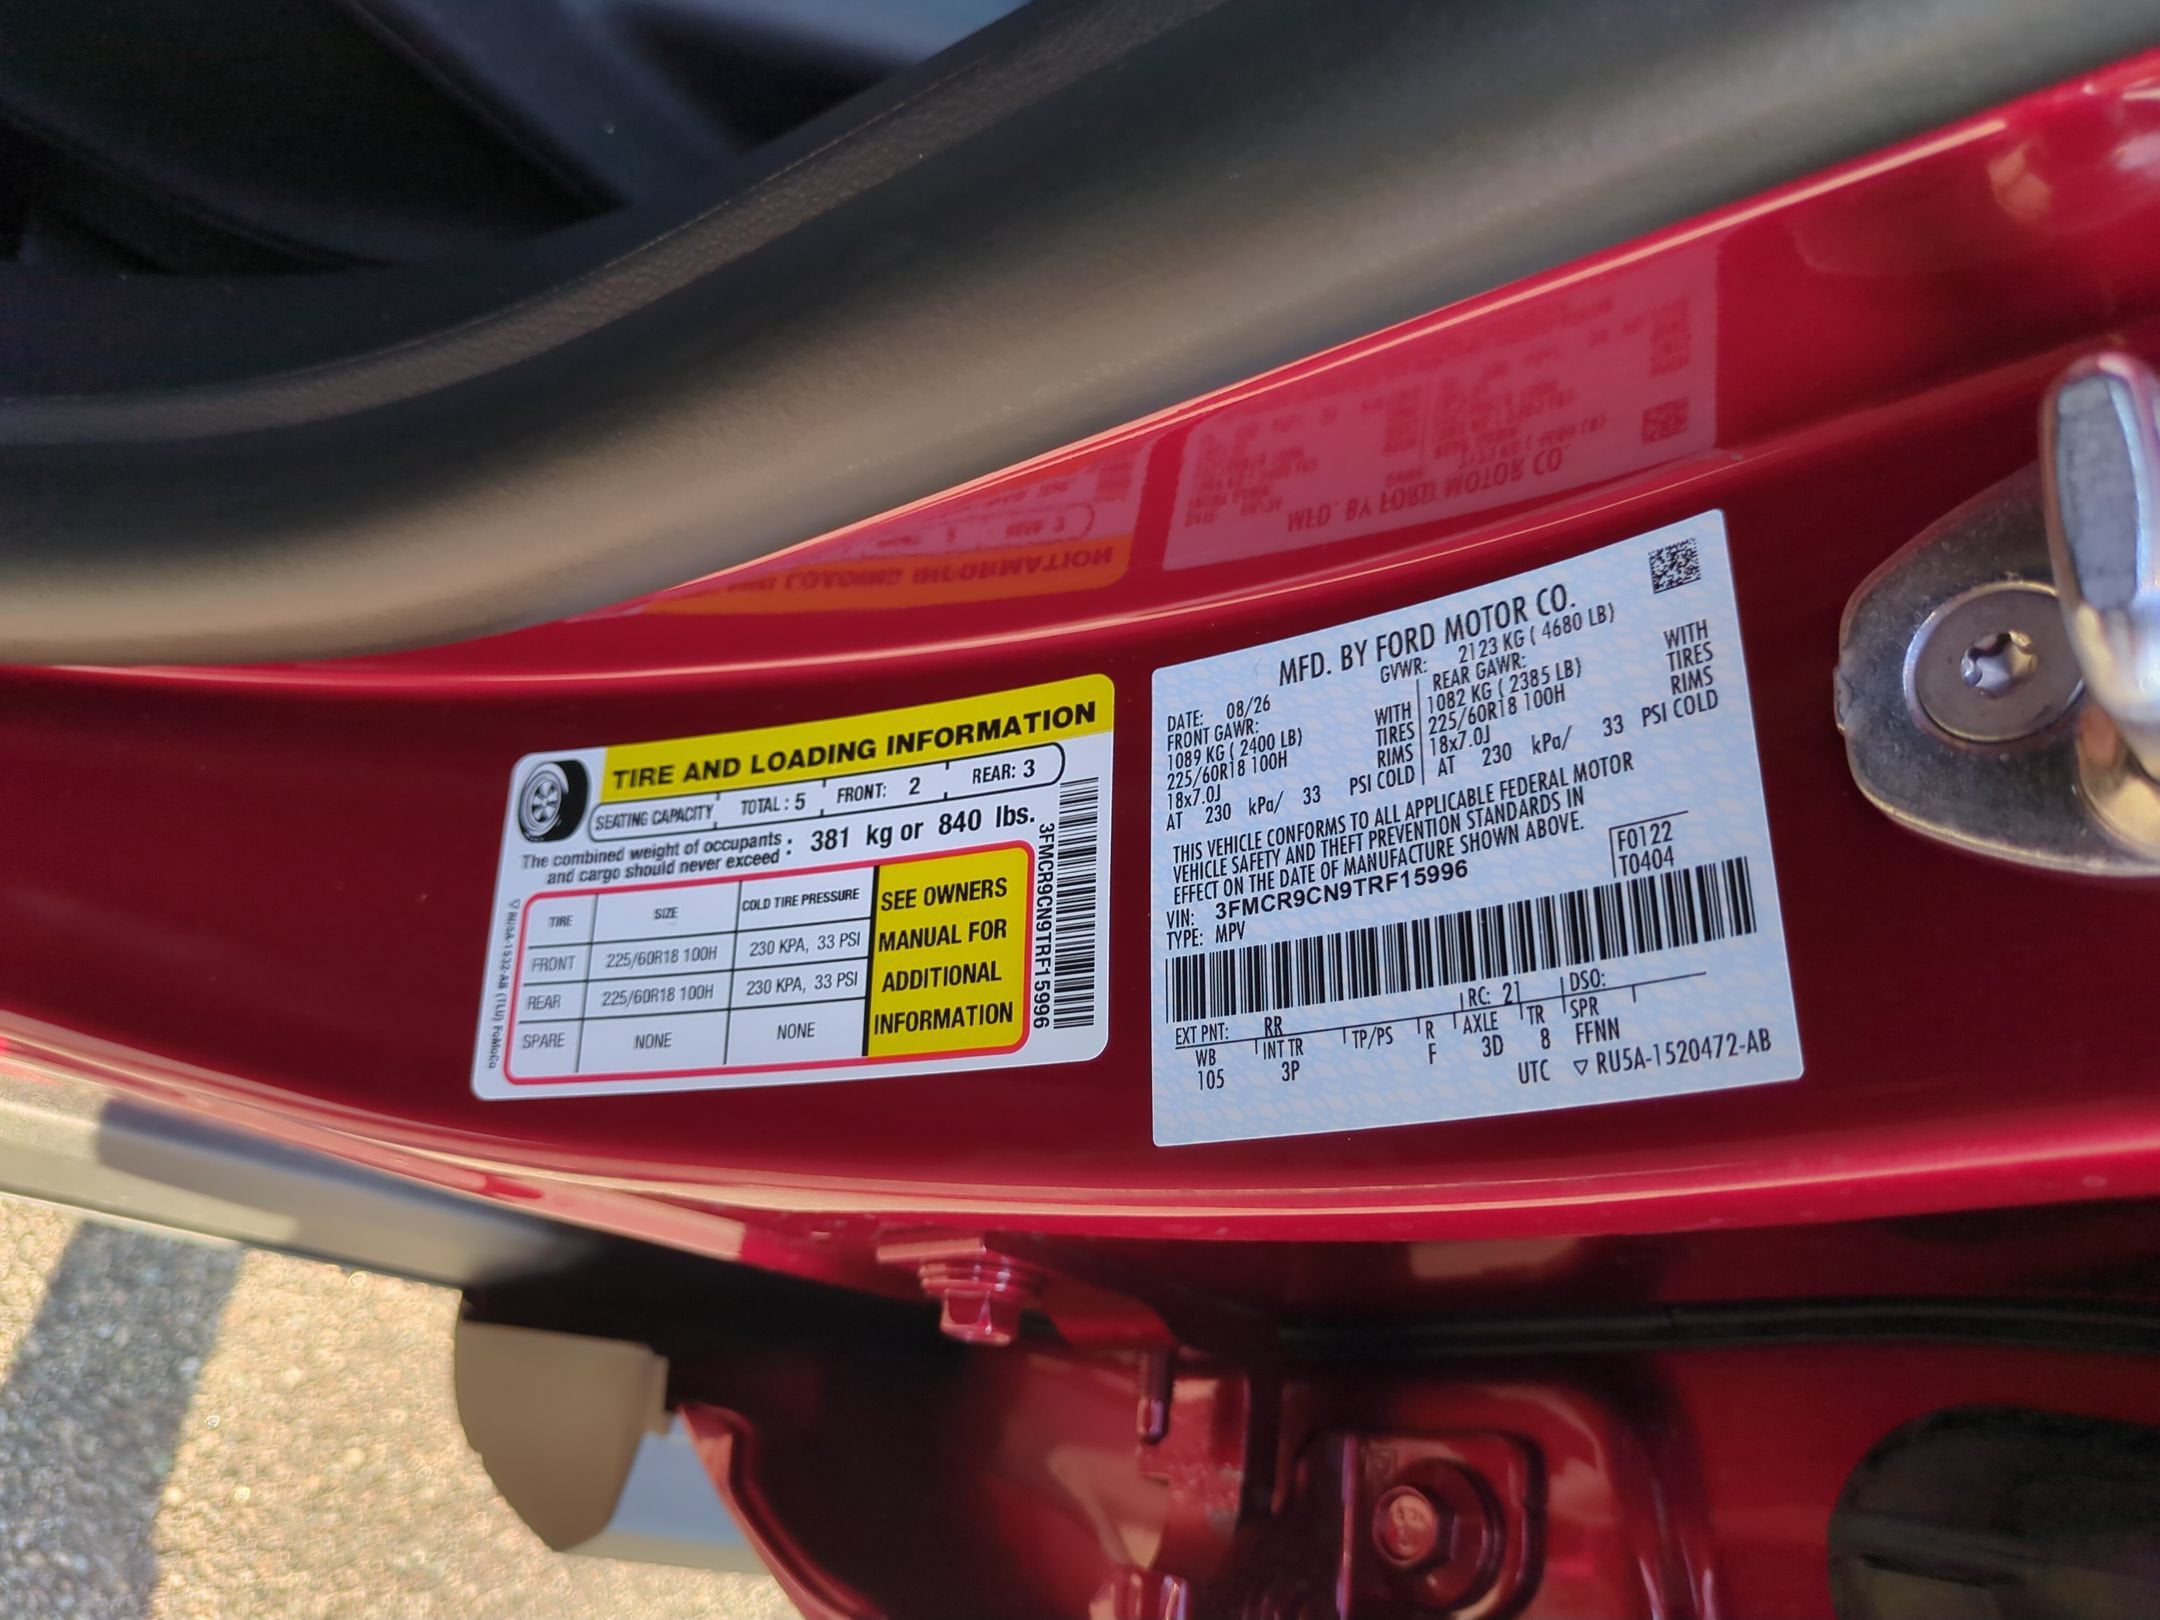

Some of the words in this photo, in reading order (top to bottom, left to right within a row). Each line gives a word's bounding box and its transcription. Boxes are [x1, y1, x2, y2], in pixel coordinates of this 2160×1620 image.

[1279, 651, 1332, 686] MFD.
[1340, 640, 1368, 671] BY
[1376, 622, 1435, 662] FORD
[1444, 596, 1528, 644] MOTOR
[1536, 584, 1576, 616] CO.
[1380, 657, 1427, 684] GVWR:
[1458, 637, 1497, 664] 2123
[1503, 630, 1524, 652] KG
[1542, 613, 1583, 639] 4680
[1589, 602, 1615, 626] LB)
[1427, 688, 1465, 713] 1082
[1472, 682, 1492, 703] KG
[1509, 666, 1550, 693] 2385
[1556, 657, 1582, 681] LB)
[1664, 619, 1708, 649] WITH
[1433, 667, 1470, 692] REAR
[1476, 652, 1526, 679] GAWR:
[1428, 697, 1517, 735] 225/60R18
[1526, 683, 1565, 711] 100H
[1666, 642, 1713, 672] TIRES
[1168, 710, 1203, 732] DATE:
[1226, 694, 1271, 719] 08/26
[1430, 725, 1490, 756] 18x7.0J
[1670, 666, 1714, 695] RIMS
[613, 765, 675, 790] TIRE
[683, 757, 741, 782] AND
[751, 739, 876, 773] LOADING
[887, 701, 1096, 756] INFORMATION
[1167, 727, 1210, 751] FRONT
[1215, 719, 1259, 742] GAWR:
[1168, 749, 1201, 770] 1089
[1206, 743, 1225, 763] KG
[1240, 734, 1275, 755] 2400
[1281, 727, 1302, 747] LB)
[1375, 702, 1411, 726] WITH
[1438, 756, 1455, 777] AT
[1482, 743, 1512, 767] 230
[1532, 725, 1572, 755] kPa/
[1603, 714, 1624, 737] 33
[1642, 702, 1667, 727] PSI
[1673, 689, 1719, 718] COLD
[1167, 761, 1246, 791] 225/60R18
[1252, 751, 1287, 773] 100H
[1375, 722, 1415, 746] TIRES
[1168, 784, 1221, 810] 18x7.0J
[1377, 744, 1413, 768] RIMS
[595, 811, 648, 831] SEATING
[652, 804, 714, 826] CAPACITY
[795, 793, 805, 810] 5
[837, 783, 886, 804] FRONT:
[909, 777, 920, 795] 2
[972, 763, 1016, 784] REAR:
[1024, 759, 1035, 778] 3
[1167, 812, 1183, 831] AT
[1205, 803, 1231, 824] 230
[1248, 791, 1284, 816] kPa/
[1303, 785, 1321, 805] 33
[1350, 774, 1371, 796] PSI
[1377, 765, 1415, 789] COLD
[1173, 842, 1203, 864] THIS
[1207, 831, 1262, 858] VEHICLE
[1267, 815, 1346, 847] CONFORMS
[1350, 811, 1369, 831] TO
[1375, 804, 1400, 826] ALL
[1405, 783, 1494, 820] APPLICABLE
[1500, 767, 1569, 800] FEDERAL
[1574, 751, 1634, 783] MOTOR
[811, 827, 849, 851] 381
[866, 823, 892, 848] kg
[900, 820, 923, 839] or
[939, 809, 982, 835] 840
[996, 805, 1035, 828] lbs.
[1173, 861, 1227, 884] VEHICLE
[1232, 849, 1281, 874] SAFETY
[1286, 843, 1316, 865] AND
[1321, 833, 1363, 857] THEFT
[1369, 807, 1461, 851] PREVENTION
[1467, 792, 1561, 829] STANDARDS
[1567, 786, 1584, 808] IN
[523, 854, 549, 869] The
[553, 846, 625, 867] combined
[631, 841, 679, 863] weight
[685, 838, 700, 854] of
[1174, 881, 1219, 906] EFFECT
[1223, 877, 1243, 895] ON
[1250, 871, 1275, 893] THE
[1280, 864, 1315, 888] DATE
[1321, 860, 1339, 879] OF
[1344, 837, 1454, 877] MANUFACTURE
[1460, 823, 1520, 854] SHOWN
[1526, 811, 1584, 842] ABOVE.
[548, 867, 574, 884] and
[579, 865, 621, 883] cargo
[625, 860, 675, 879] should
[680, 856, 721, 873] never
[742, 898, 770, 912] COLD
[774, 895, 799, 908] TIRE
[801, 888, 860, 905] PRESSURE
[881, 888, 917, 911] SEE
[924, 877, 1008, 906] OWNERS
[1166, 908, 1194, 929] VIN:
[1215, 859, 1468, 920] 3FMCR9CN9TRF15996
[549, 915, 573, 928] TIRE
[654, 907, 678, 919] SIZE
[1034, 823, 1054, 1029] 3FMCR9CN9TRF15996
[750, 940, 774, 957] 230
[817, 934, 835, 949] 33
[840, 931, 860, 947] PSI
[879, 924, 962, 952] MANUAL
[968, 918, 1007, 942] FOR
[1167, 929, 1203, 950] TYPE:
[1216, 921, 1246, 943] MPV
[532, 955, 577, 972] FRONT
[606, 948, 679, 969] 225/60R18
[684, 946, 718, 962] 100H
[747, 980, 771, 996] 230
[815, 974, 832, 988] 33
[837, 971, 858, 987] PSI
[881, 960, 1002, 992] ADDITIONAL
[1570, 968, 1605, 992] DSO:
[527, 995, 561, 1010] REAR
[602, 987, 675, 1007] 225/60R18
[680, 984, 714, 1000] 100H
[1468, 986, 1490, 1007] RC:
[1570, 997, 1599, 1019] SPR
[875, 1001, 1013, 1035] INFORMATION
[1462, 1011, 1500, 1035] AXLE
[1527, 1005, 1545, 1025] TR
[523, 1032, 566, 1048] SPARE
[635, 1032, 672, 1049] NONE
[777, 1022, 815, 1040] NONE
[1176, 1026, 1198, 1045] EXT
[1201, 1022, 1229, 1042] PNT:
[1264, 1016, 1282, 1037] RR
[1352, 1026, 1393, 1050] TP/PS
[1576, 1018, 1620, 1045] FFNN
[1196, 1049, 1216, 1068] WB
[1263, 1040, 1286, 1060] INT
[1288, 1038, 1303, 1057] TR
[1482, 1035, 1504, 1058] 3D
[1518, 1060, 1550, 1085] UTC
[1596, 1028, 1772, 1075] RU5A-1520472-AB
[1198, 1069, 1224, 1090] 105
[1282, 1060, 1300, 1081] 3P
